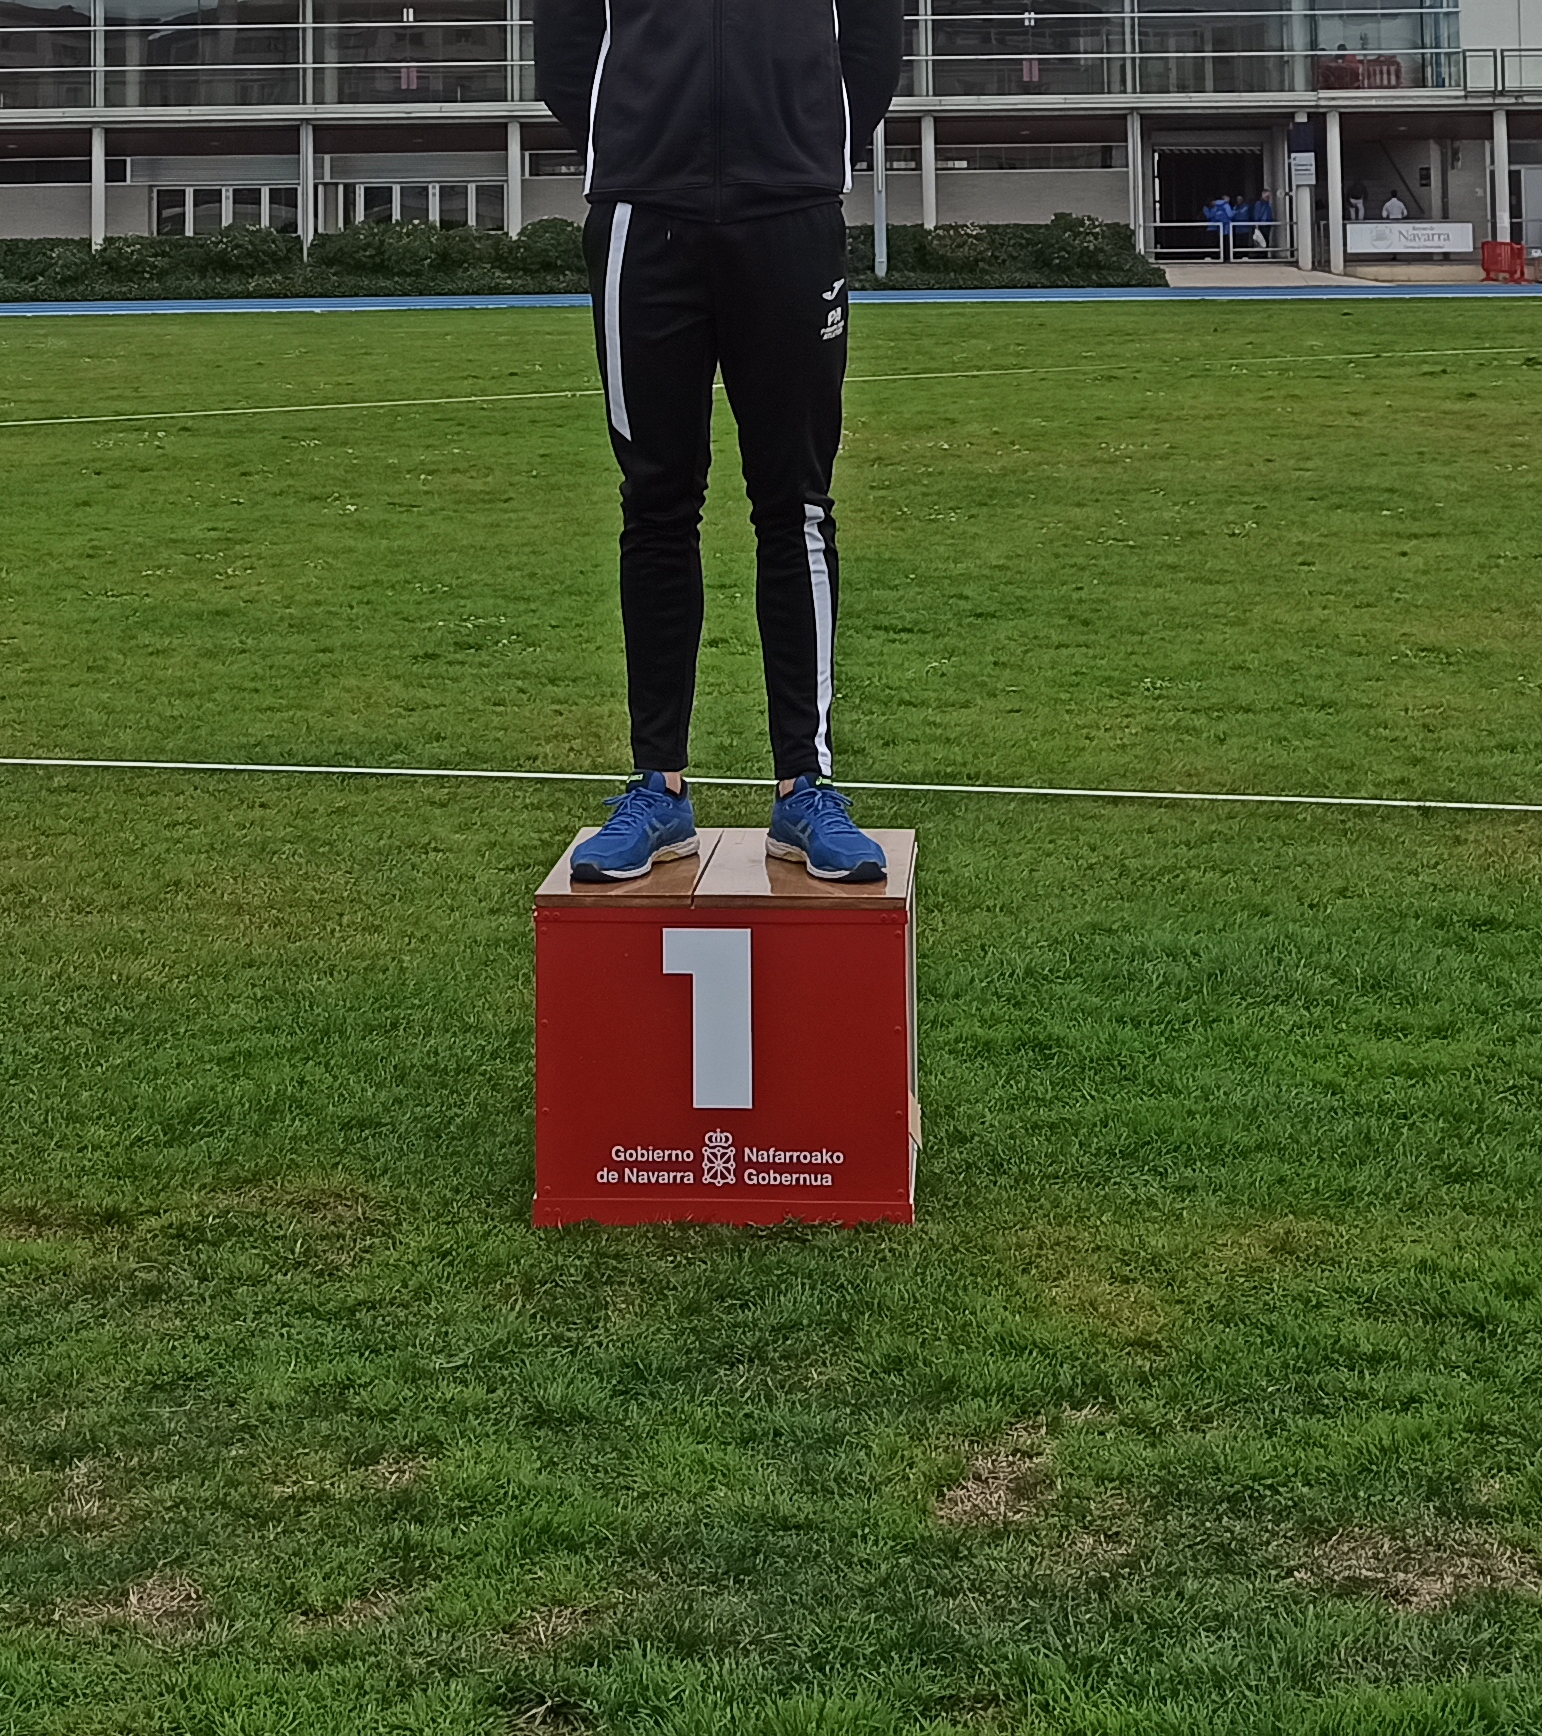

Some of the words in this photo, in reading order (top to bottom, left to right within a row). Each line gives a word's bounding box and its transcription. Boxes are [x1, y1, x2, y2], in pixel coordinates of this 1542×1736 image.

[1397, 229, 1451, 242] Navarra
[662, 928, 753, 1109] 1
[611, 1145, 694, 1162] Gobierno
[743, 1146, 844, 1164] Nafarroako
[596, 1166, 618, 1183] de
[624, 1167, 694, 1184] Navarra
[743, 1169, 832, 1186] Gobernua
